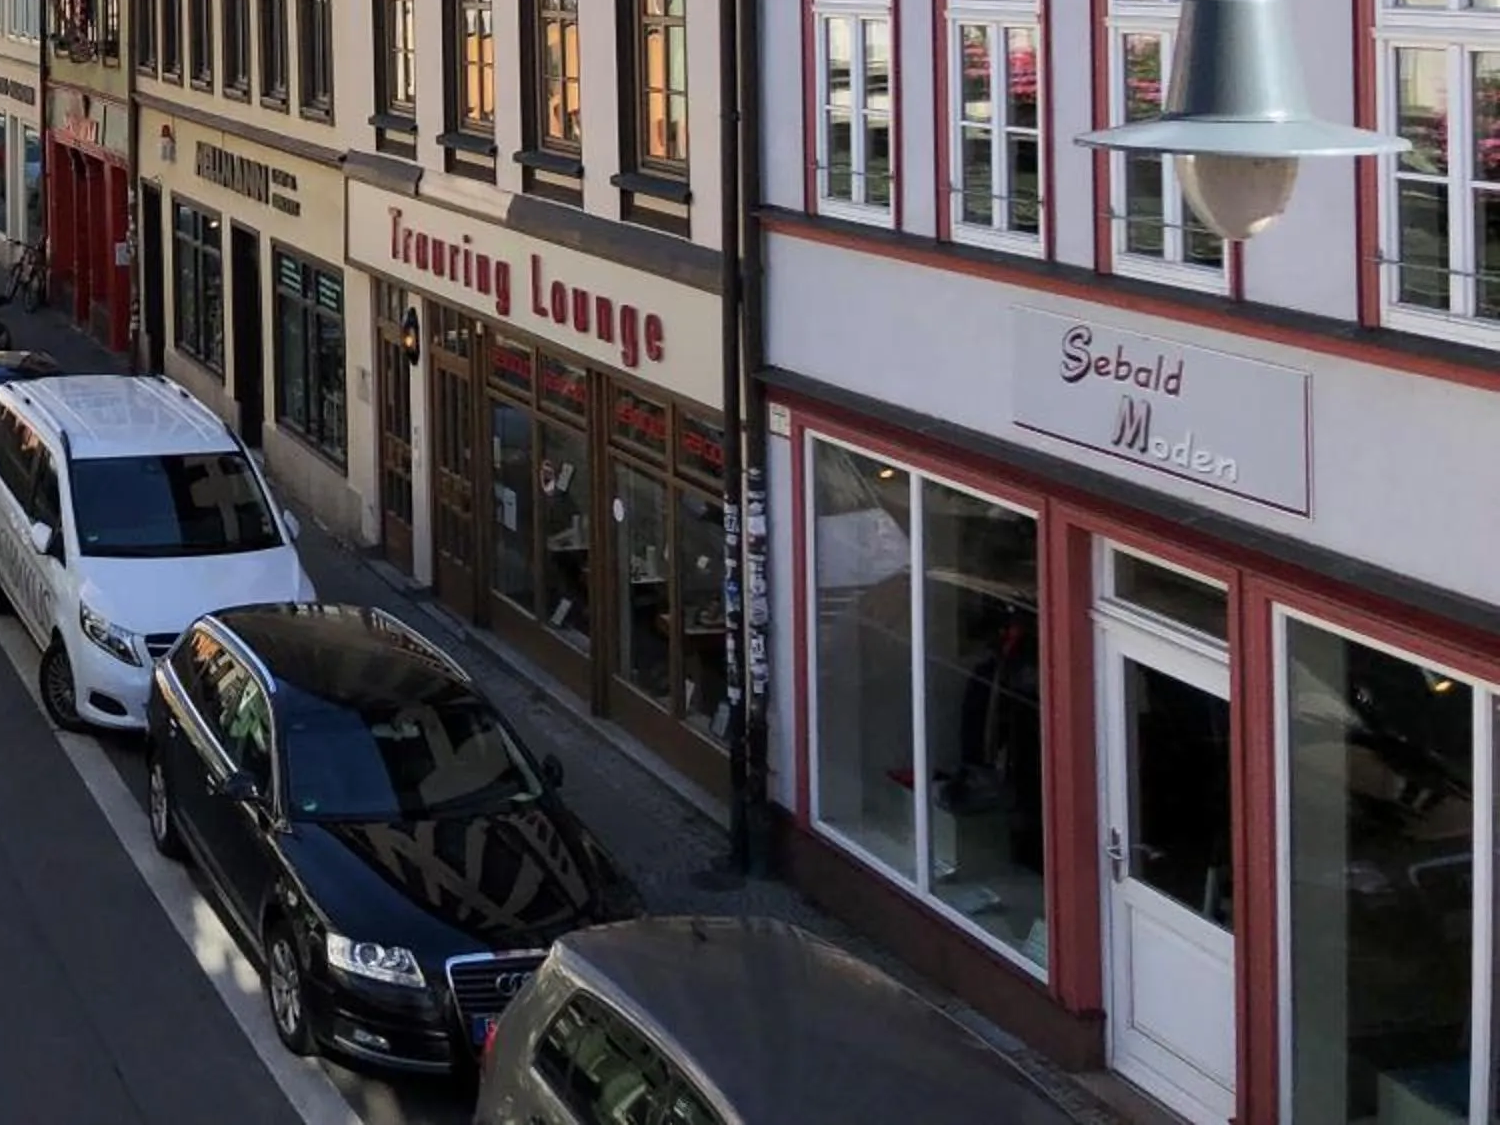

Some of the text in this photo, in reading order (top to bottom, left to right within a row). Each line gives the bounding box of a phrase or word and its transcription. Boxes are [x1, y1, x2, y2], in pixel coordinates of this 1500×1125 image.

[388, 206, 665, 368] Trauring Lounge
[1060, 325, 1185, 396] Sebald
[1111, 394, 1239, 485] Moden
